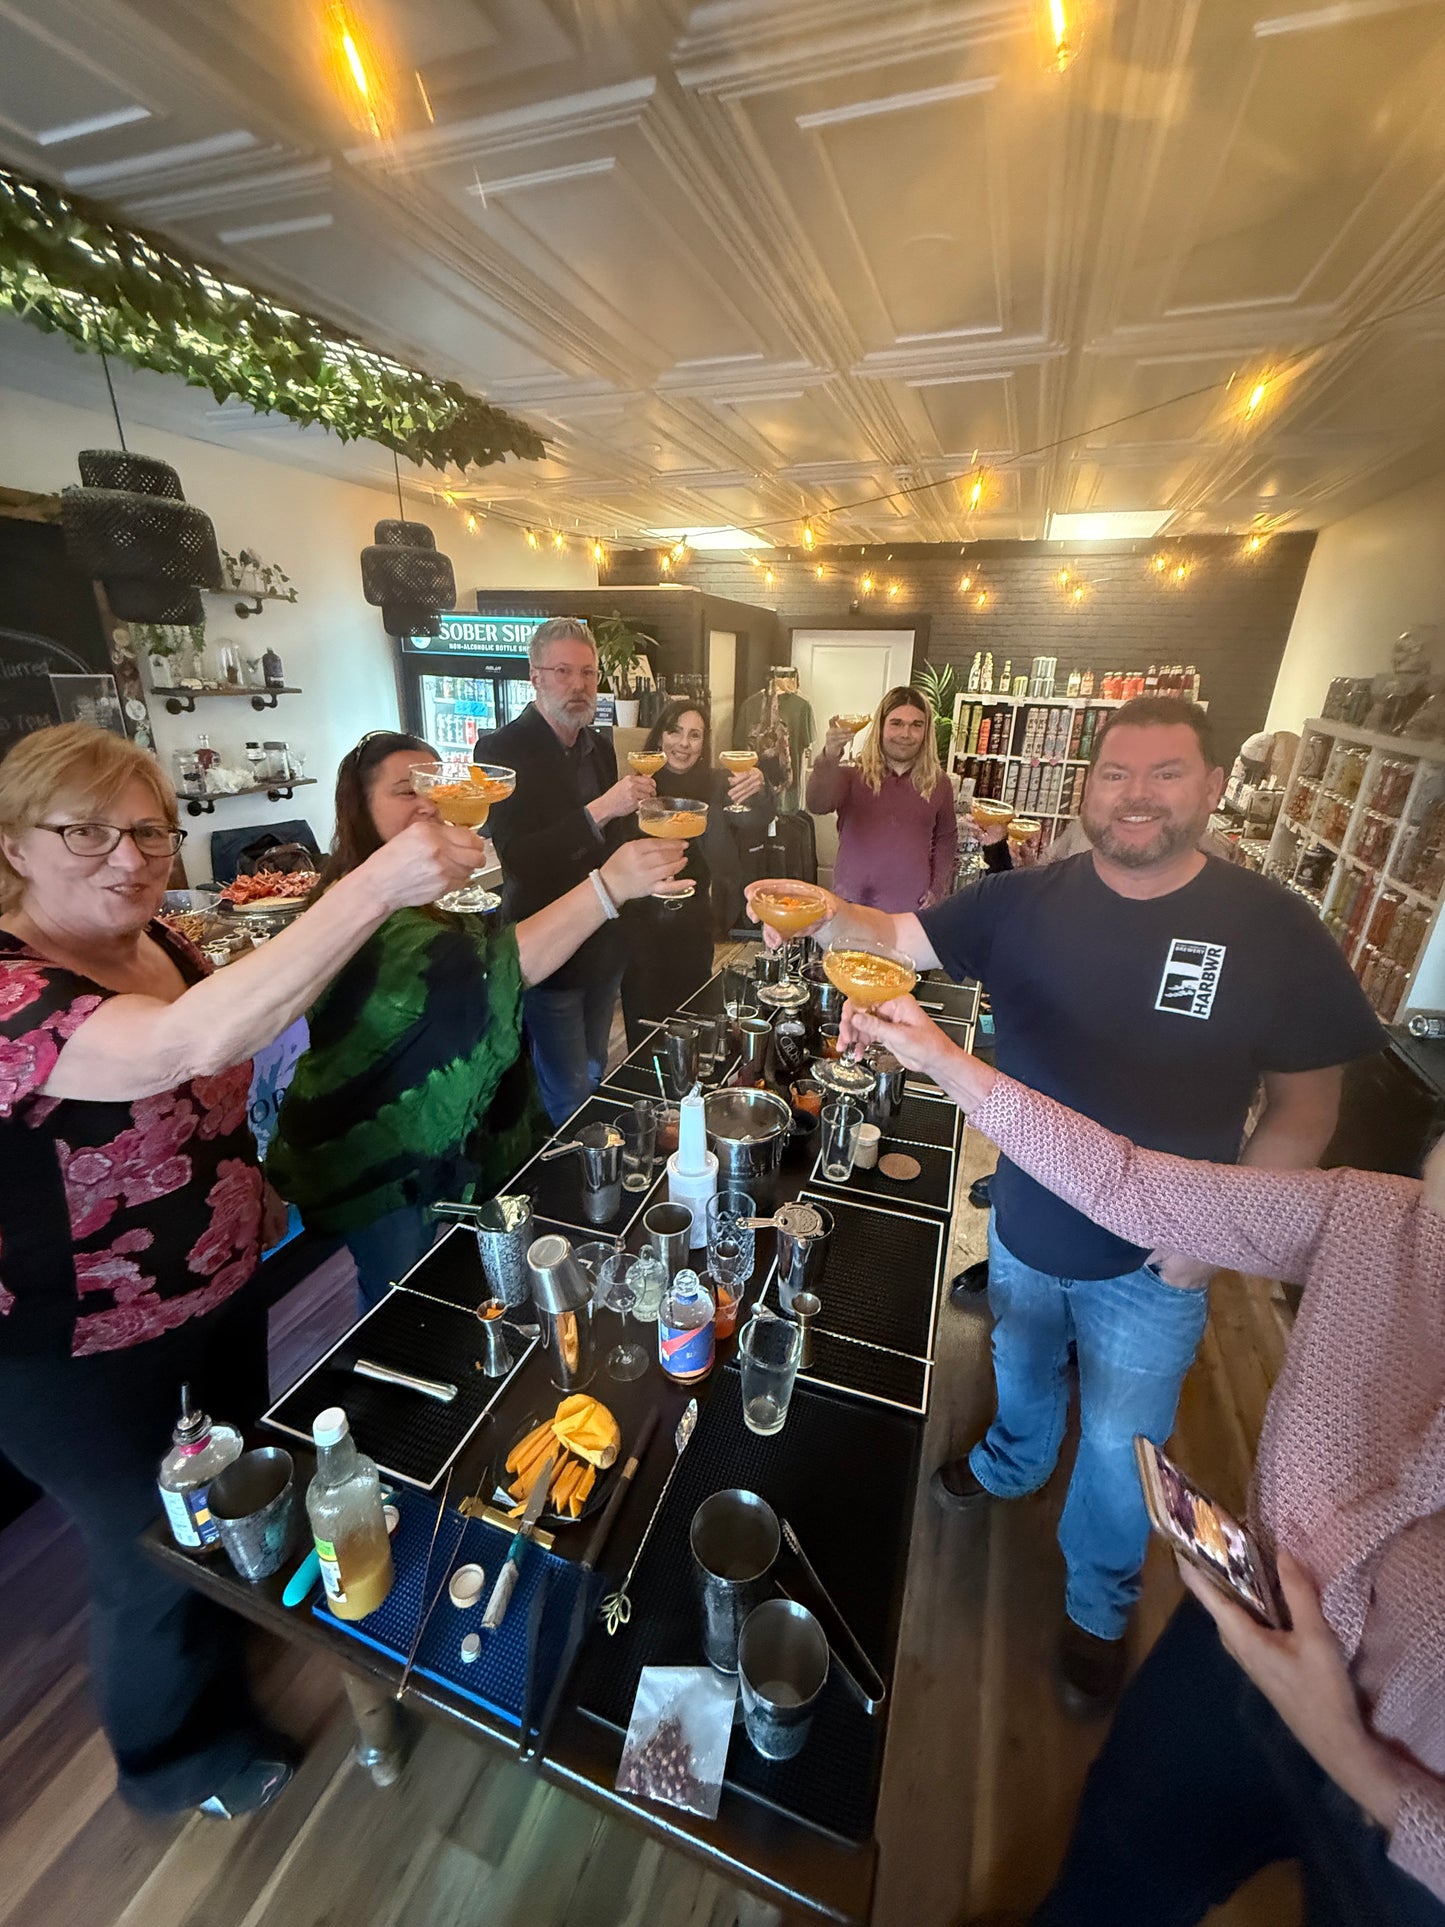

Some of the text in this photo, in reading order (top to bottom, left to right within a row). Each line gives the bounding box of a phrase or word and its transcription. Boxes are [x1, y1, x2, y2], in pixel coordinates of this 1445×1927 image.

[439, 622, 498, 641] SOBER
[449, 643, 494, 652] NON-ALCOHOLIC
[496, 644, 517, 652] BOTTLE
[1193, 947, 1222, 1015] HARBWR
